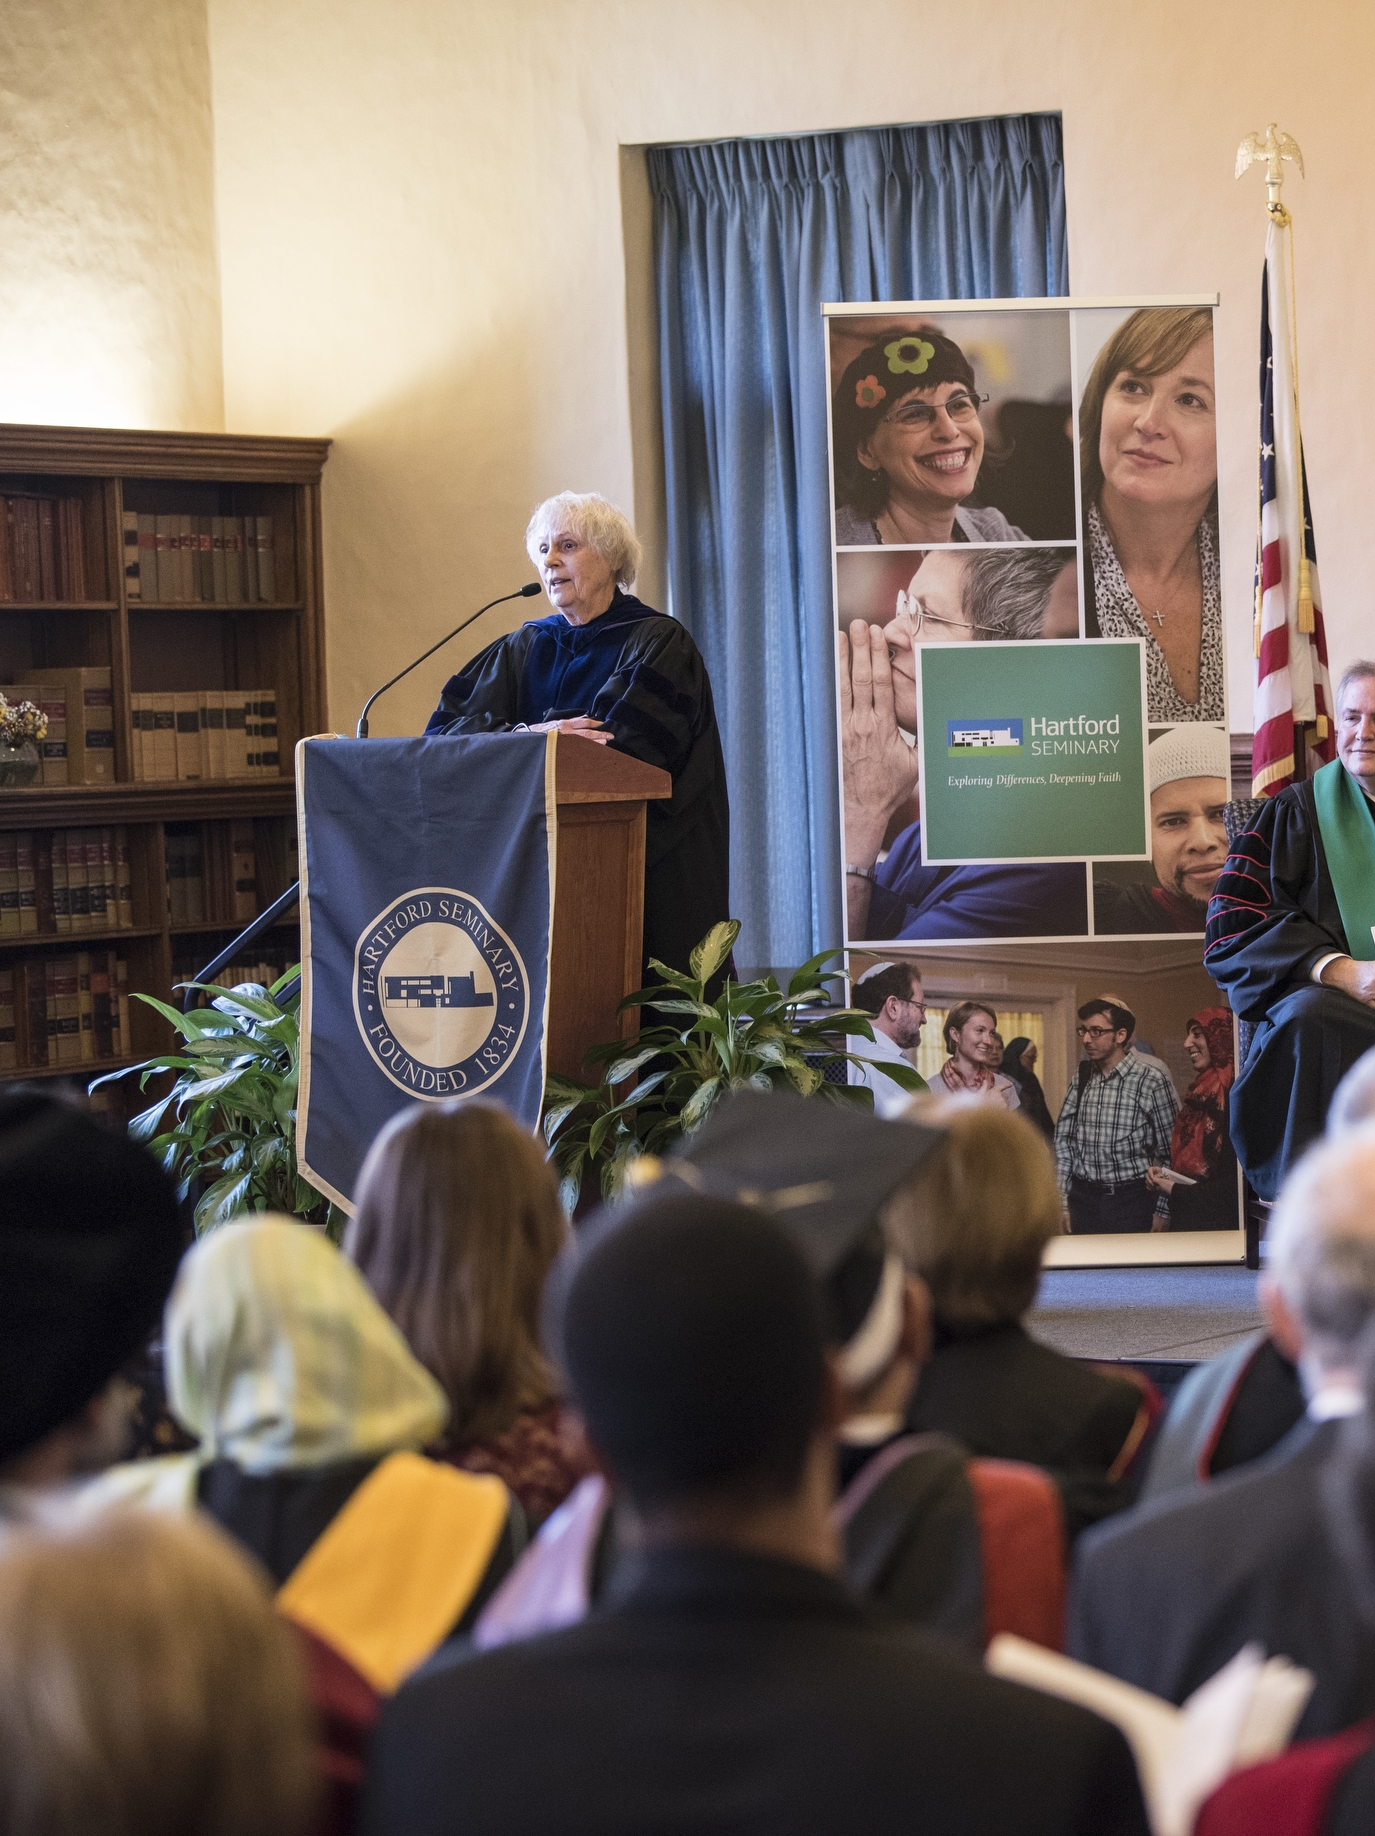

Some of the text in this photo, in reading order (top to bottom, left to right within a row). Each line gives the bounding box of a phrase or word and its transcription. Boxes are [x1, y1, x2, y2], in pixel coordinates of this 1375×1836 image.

[1030, 714, 1120, 737] Hartford
[1031, 739, 1121, 756] SEMINARY
[948, 771, 1122, 789] Exploring Differences, Deepening Faith
[363, 899, 519, 995] HARTFORD SEMINARY
[369, 1022, 516, 1092] FOUNDED 1834
